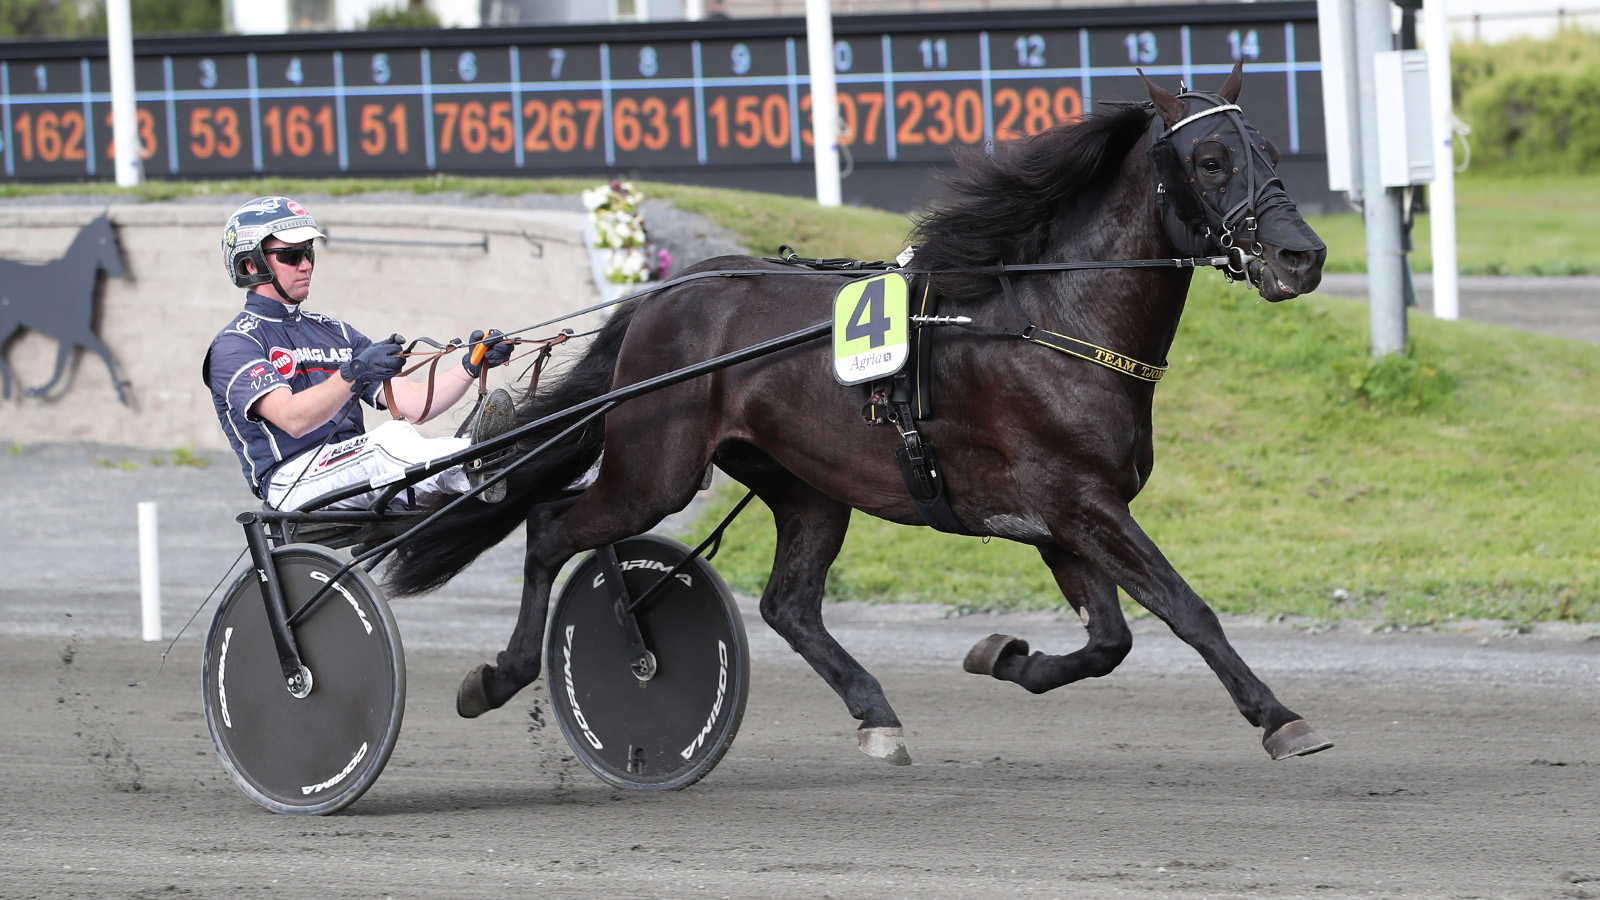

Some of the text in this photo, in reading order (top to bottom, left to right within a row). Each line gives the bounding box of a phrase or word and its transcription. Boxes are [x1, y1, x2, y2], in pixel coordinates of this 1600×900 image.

[35, 65, 47, 92] 1
[199, 59, 218, 89] 3
[286, 57, 304, 85] 4
[371, 53, 392, 84] 5
[457, 51, 478, 82] 6
[548, 48, 566, 79] 7
[638, 46, 658, 78] 8
[731, 43, 752, 75] 9
[918, 38, 948, 69] 11
[1014, 34, 1046, 67] 12
[1124, 31, 1158, 64] 13
[1226, 29, 1260, 61] 14
[15, 110, 86, 161] 162
[190, 107, 241, 158] 53
[264, 105, 334, 156] 161
[360, 103, 408, 154] 51
[433, 101, 514, 153] 765
[523, 99, 602, 152] 267
[613, 97, 692, 150] 631
[709, 95, 790, 148] 150
[896, 89, 984, 145] 230
[993, 86, 1083, 141] 289
[846, 278, 891, 349] 4
[272, 353, 292, 370] RIIS
[850, 352, 882, 371] Agria
[1095, 349, 1137, 373] TEAM
[563, 624, 603, 750] CORIMA
[680, 639, 728, 760] CORIMA
[301, 741, 368, 795] CORIMA
